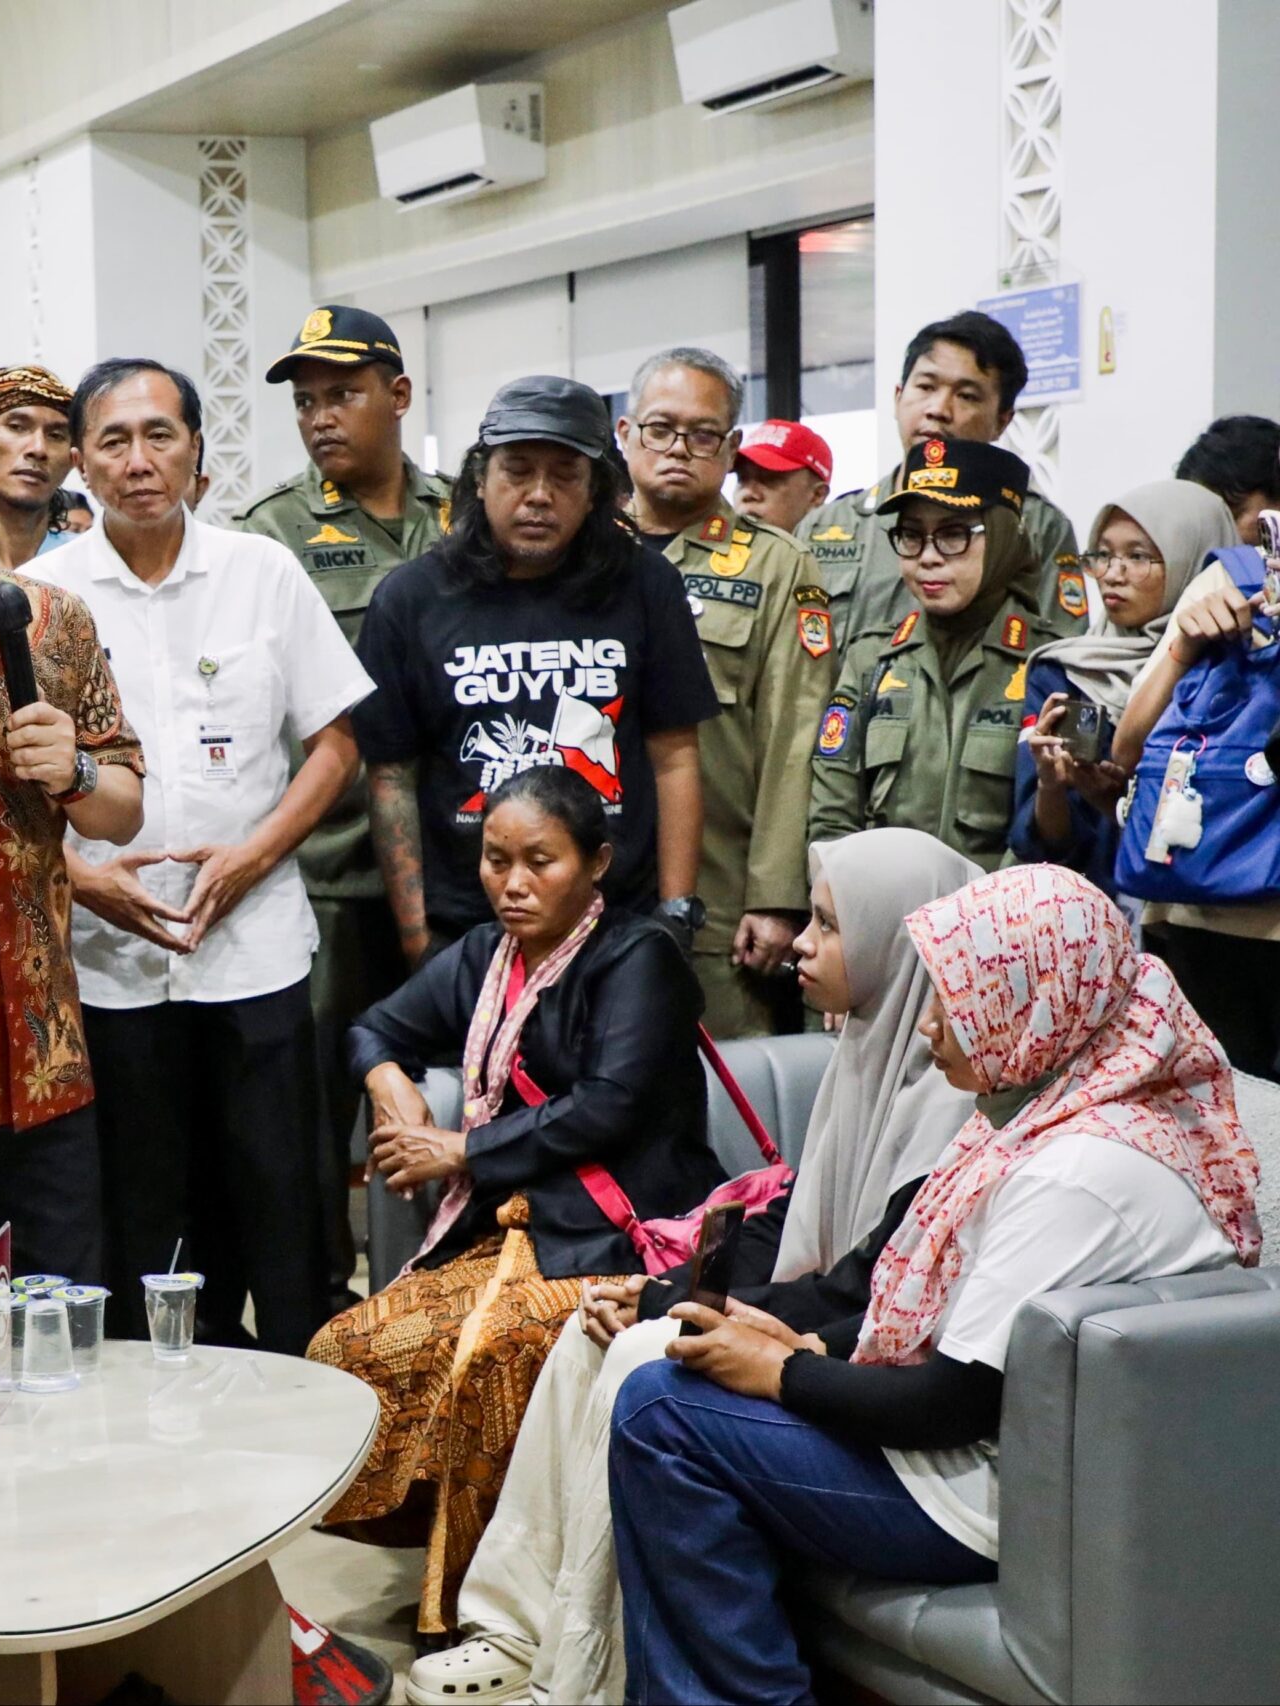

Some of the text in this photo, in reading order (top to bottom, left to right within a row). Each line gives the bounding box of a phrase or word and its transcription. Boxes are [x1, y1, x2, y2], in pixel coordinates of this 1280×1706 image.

[314, 551, 366, 569] RICKY
[686, 579, 756, 601] POL PP
[443, 638, 627, 677] JATENG
[454, 667, 619, 706] GUYUB
[976, 708, 1015, 725] POL
